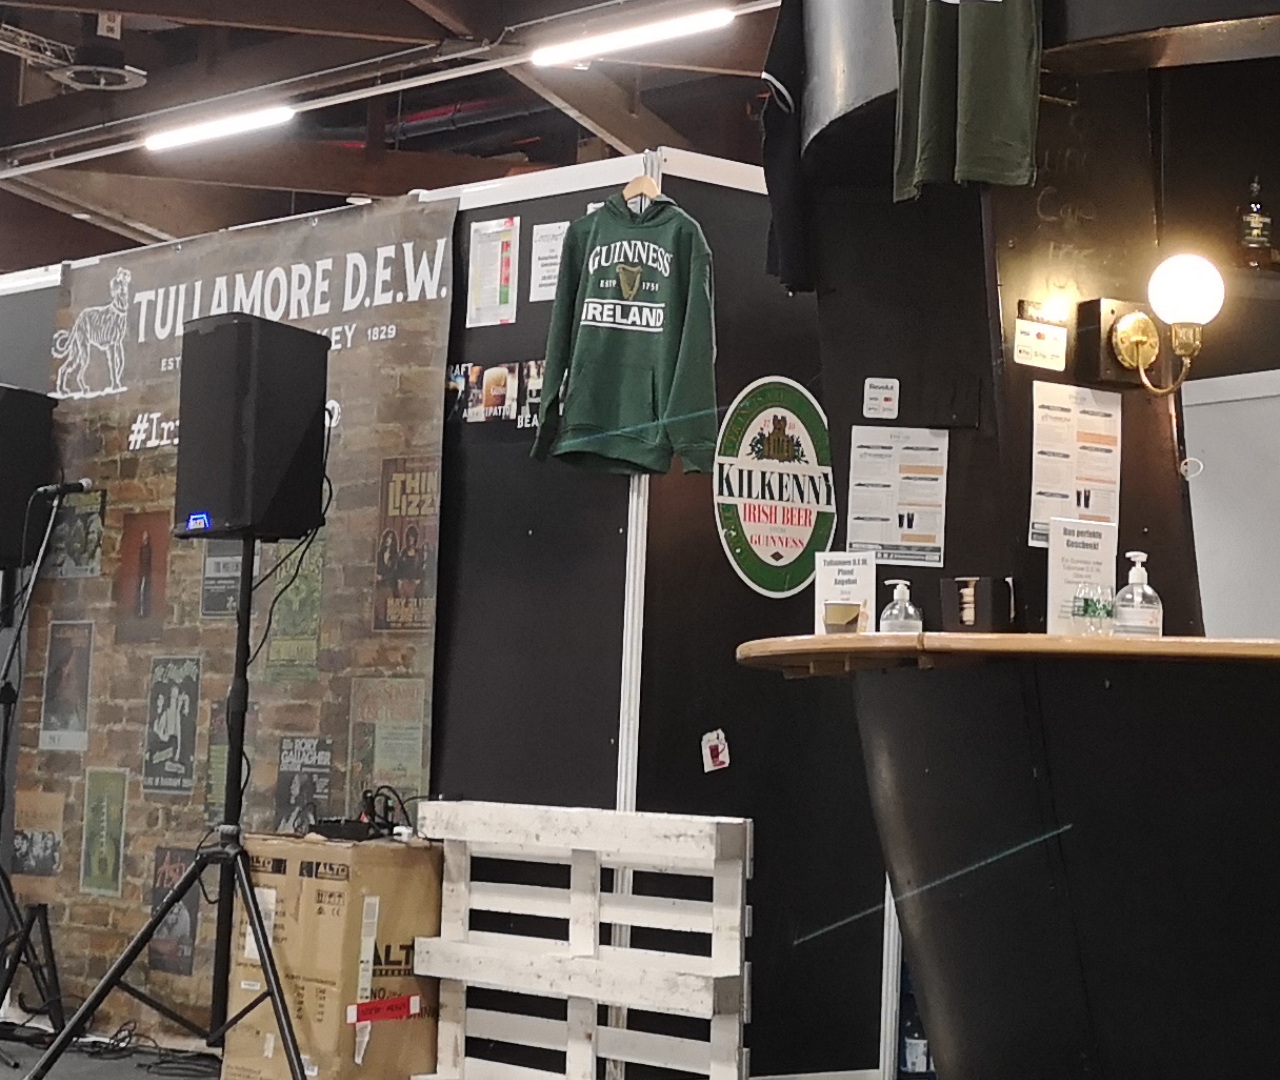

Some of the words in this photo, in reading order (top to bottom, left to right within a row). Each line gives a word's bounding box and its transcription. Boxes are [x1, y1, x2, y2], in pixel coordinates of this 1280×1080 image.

[587, 240, 672, 278] GUINNESS
[342, 237, 448, 313] D.E.W.
[581, 302, 665, 327] IRELAND
[366, 324, 398, 342] 1829
[717, 463, 834, 507] KILKENNY
[742, 502, 778, 524] IRISH
[781, 505, 813, 527] BEER
[749, 533, 805, 549] GUINNESS
[373, 941, 414, 967] ALT
